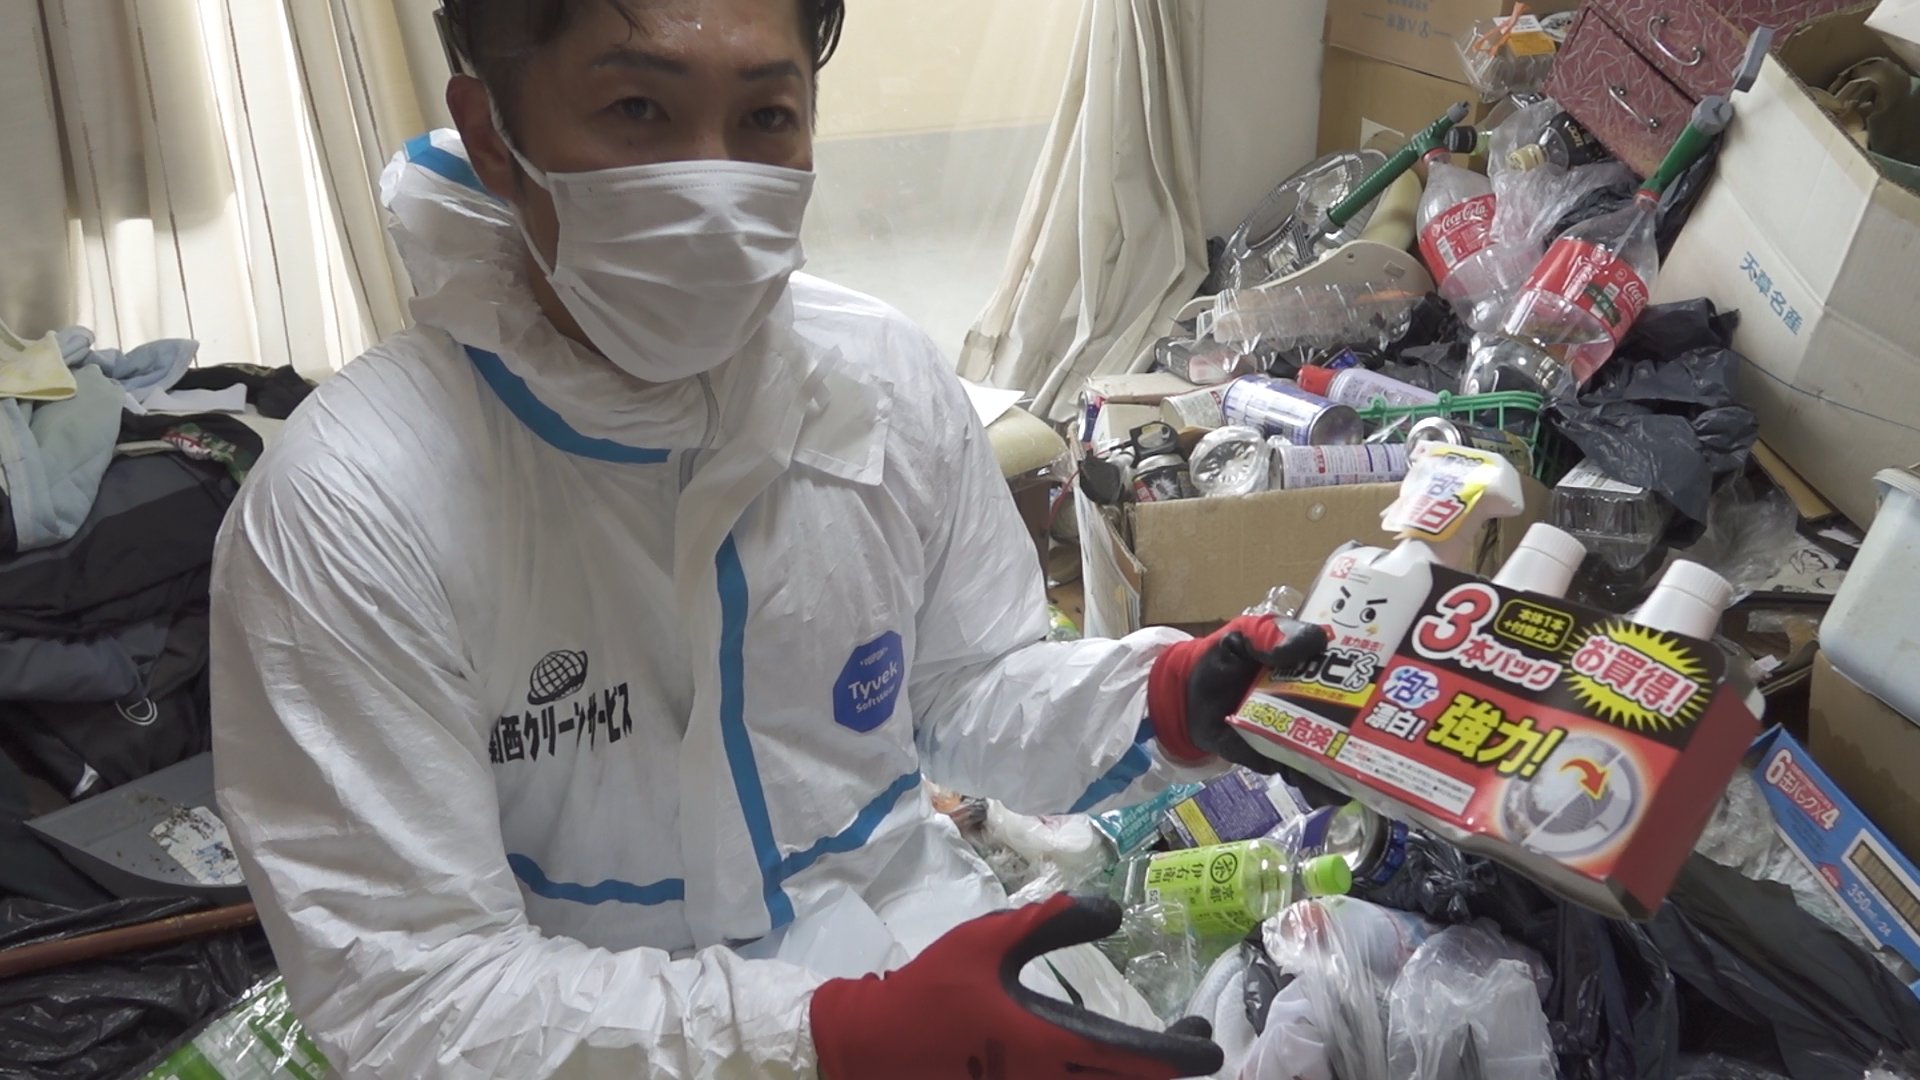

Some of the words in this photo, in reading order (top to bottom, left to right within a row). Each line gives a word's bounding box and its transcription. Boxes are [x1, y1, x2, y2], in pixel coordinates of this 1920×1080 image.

[1739, 250, 1804, 336] 天草名産
[848, 660, 898, 701] Tyvek
[1573, 636, 1698, 717] お買得!
[1425, 692, 1567, 778] 強力!
